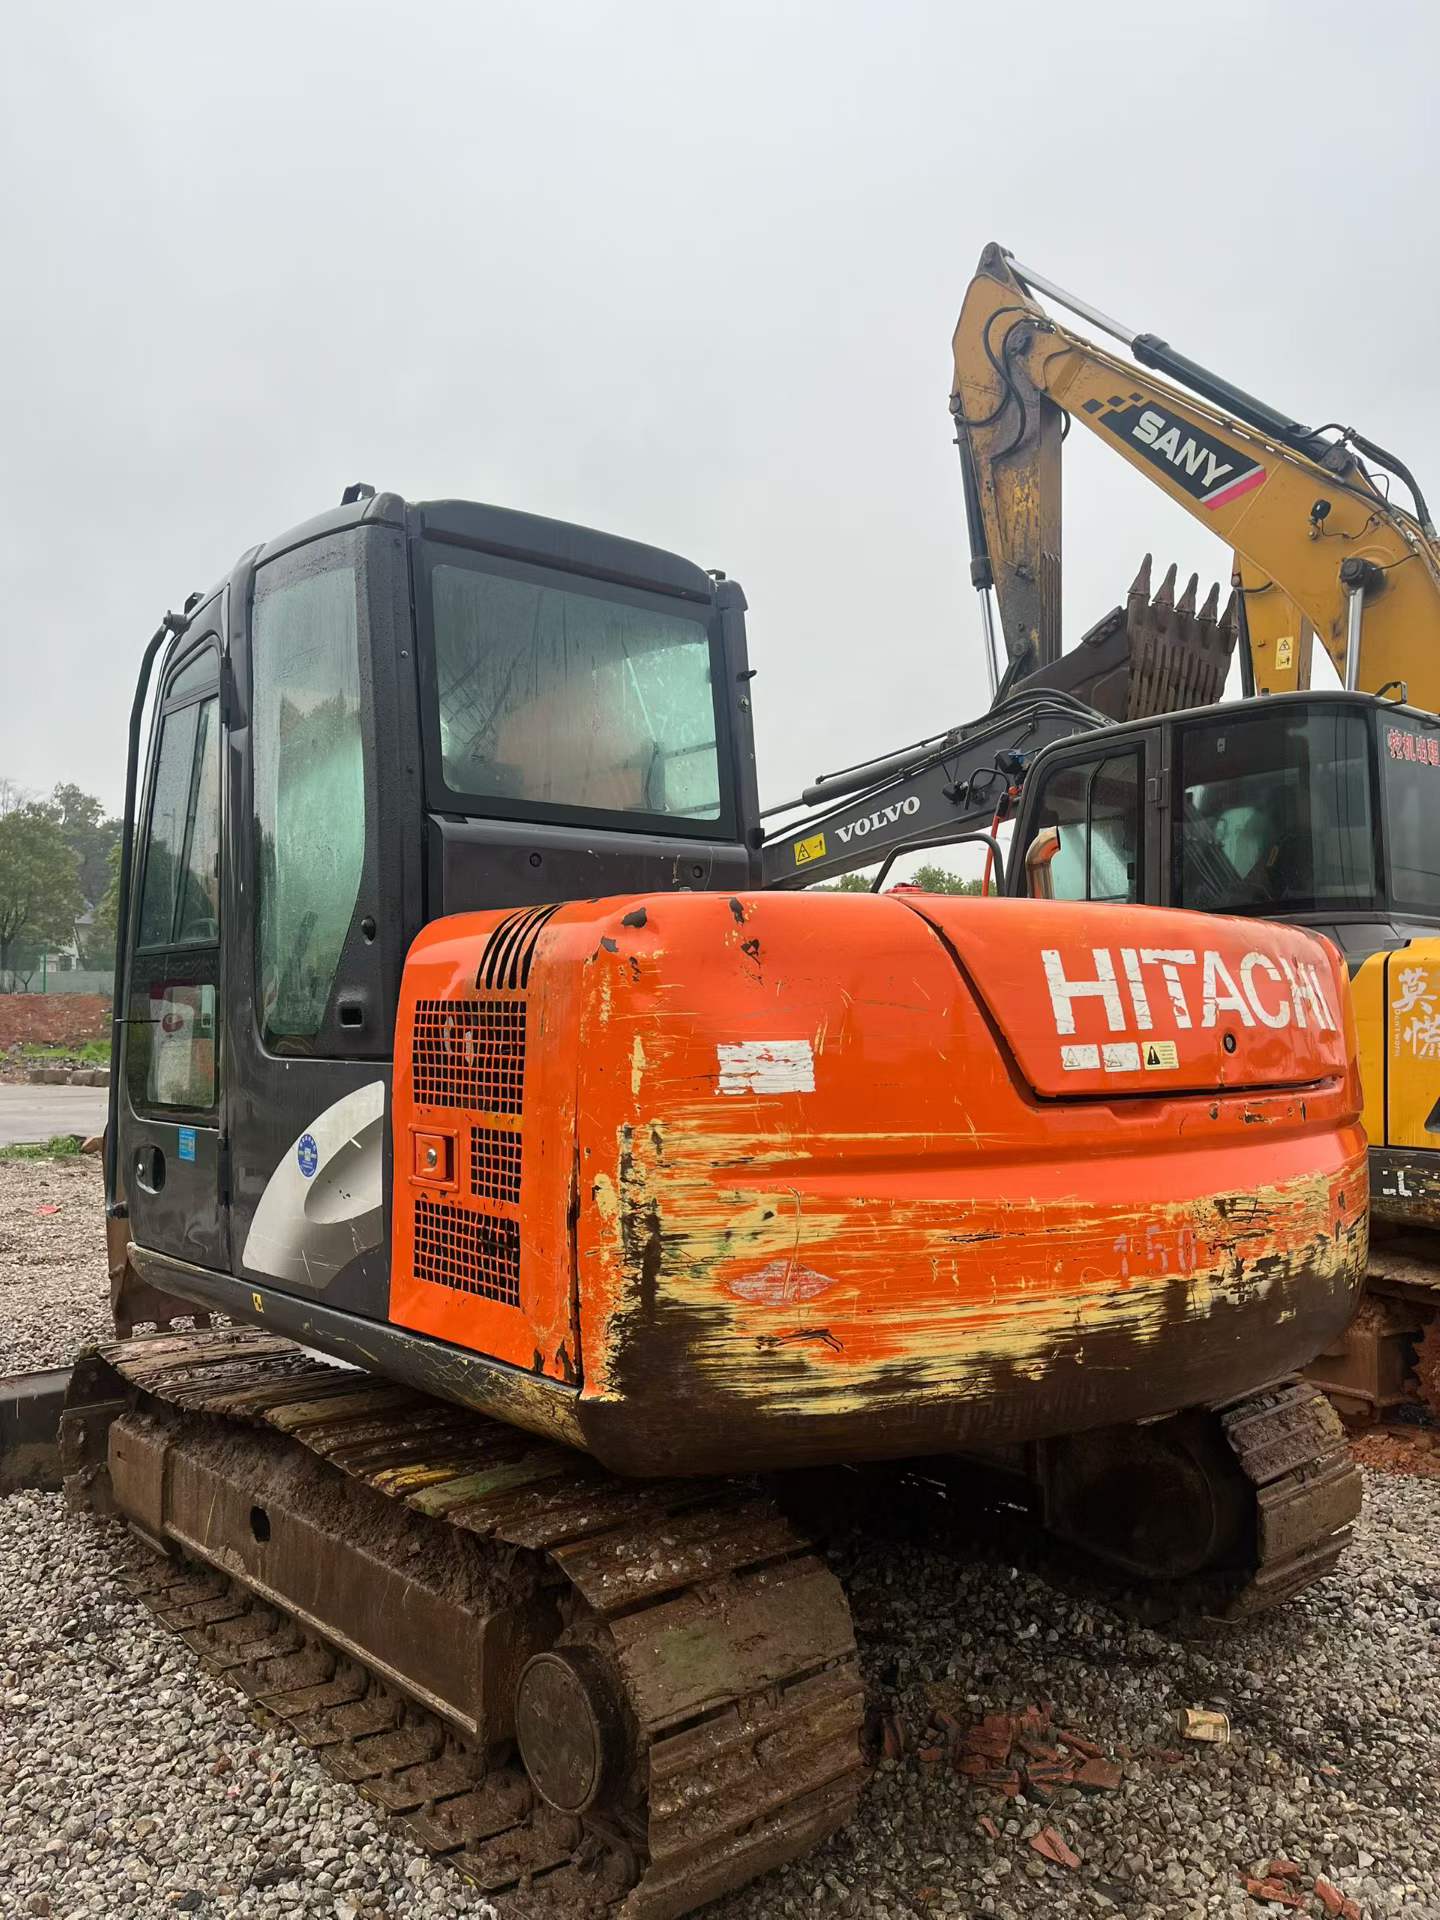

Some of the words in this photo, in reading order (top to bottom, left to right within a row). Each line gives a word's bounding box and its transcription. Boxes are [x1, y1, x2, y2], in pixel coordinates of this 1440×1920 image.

[1132, 411, 1234, 487] SANY
[835, 796, 920, 842] VOLVO
[1041, 948, 1336, 1034] HITACHI
